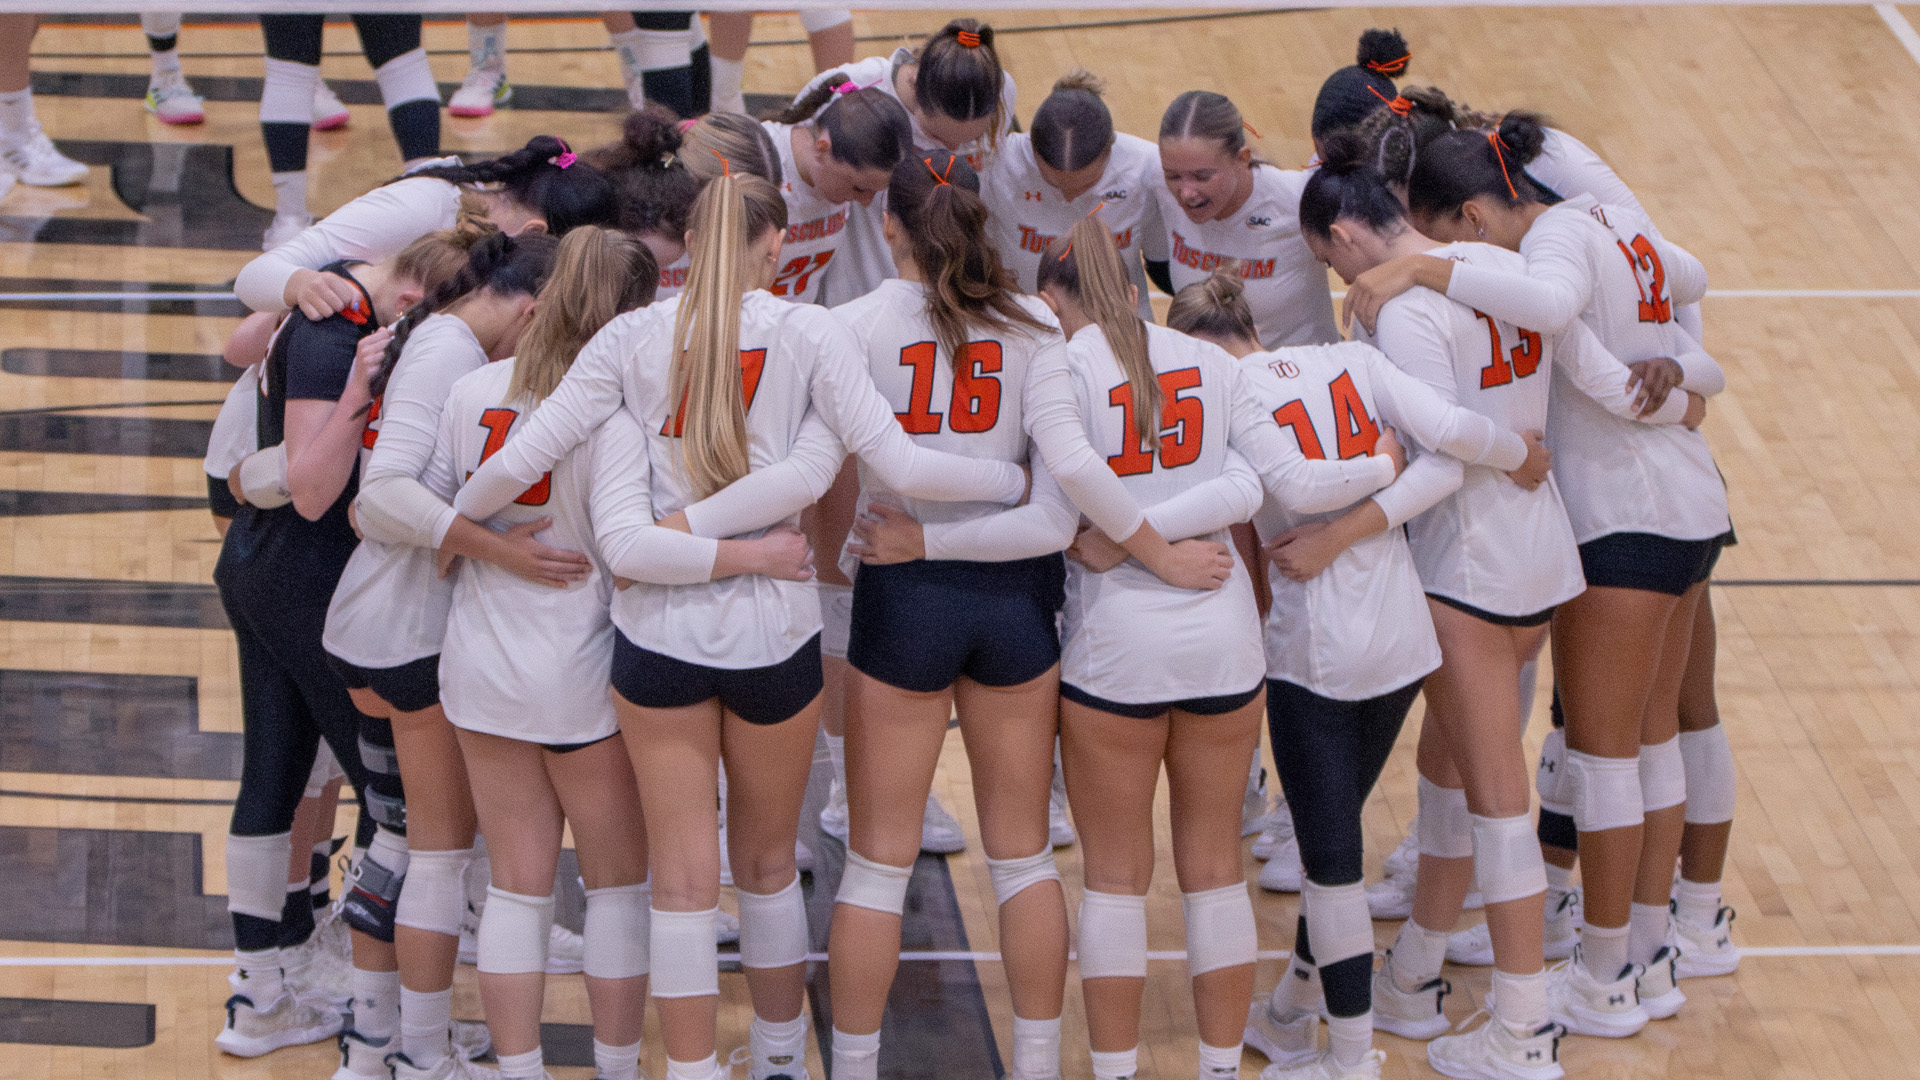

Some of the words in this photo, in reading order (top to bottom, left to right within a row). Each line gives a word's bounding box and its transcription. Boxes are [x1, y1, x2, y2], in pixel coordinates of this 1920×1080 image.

[1248, 216, 1272, 227] SAC
[1616, 233, 1671, 324] 12
[893, 339, 1003, 435] 16
[1268, 359, 1300, 379] TU
[1472, 308, 1543, 390] 13
[1107, 366, 1203, 478] 15
[1272, 368, 1383, 461] 14
